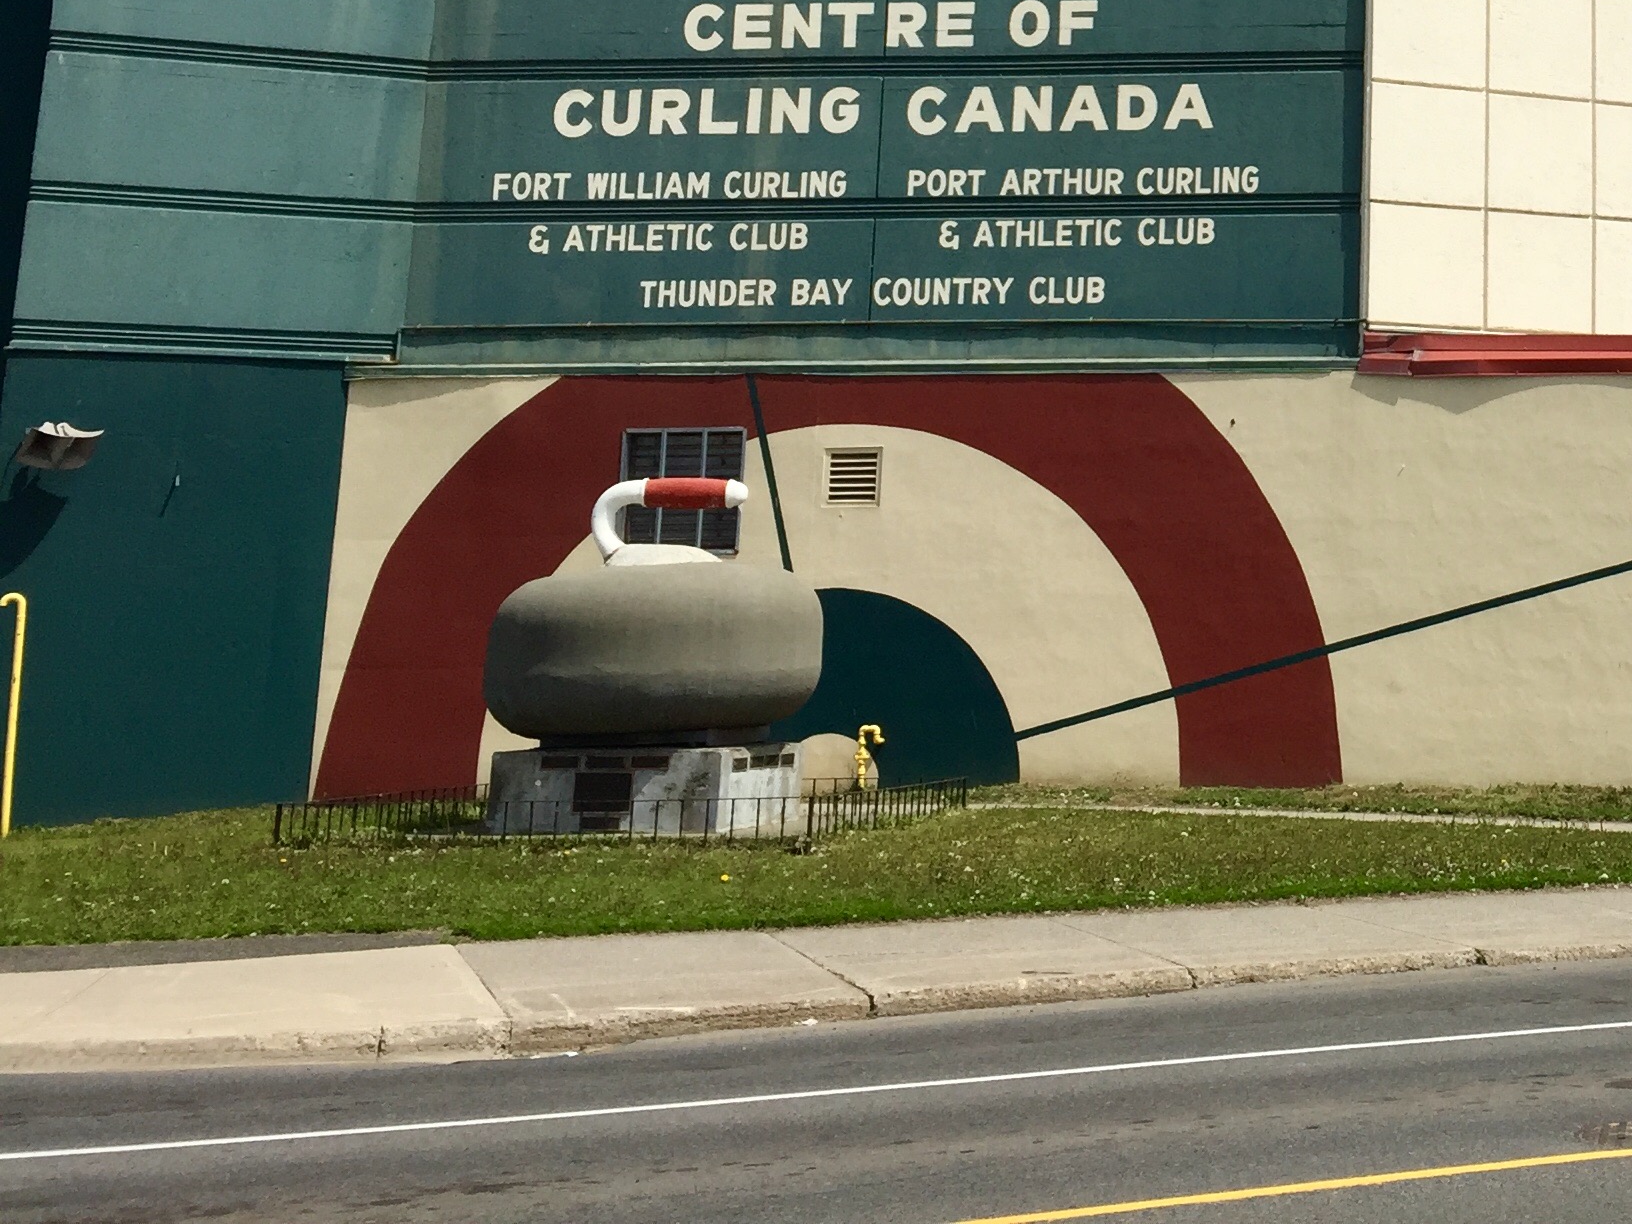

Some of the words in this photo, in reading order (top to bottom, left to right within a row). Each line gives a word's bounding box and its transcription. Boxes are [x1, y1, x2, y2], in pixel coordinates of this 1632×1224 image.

[683, 1, 976, 51] CENTRE
[1009, 0, 1099, 48] OF
[553, 86, 861, 137] CURLING
[907, 83, 1214, 136] CANADA
[492, 171, 572, 201] FORT
[587, 170, 711, 201] WILLIAM
[723, 169, 847, 199] CURLING
[907, 168, 987, 197] PORT
[999, 167, 1125, 196] ARTHUR
[1136, 165, 1259, 196] CURLING
[528, 224, 550, 255] &
[562, 222, 715, 253] ATHLETIC
[729, 221, 809, 251] CLUB
[938, 220, 960, 250] &
[972, 218, 1122, 248] ATHLETIC
[1137, 216, 1215, 246] CLUB
[640, 278, 777, 309] THUNDER
[791, 277, 853, 307] BAY
[873, 276, 1015, 308] COUNTRY
[1029, 275, 1106, 305] CLUB
